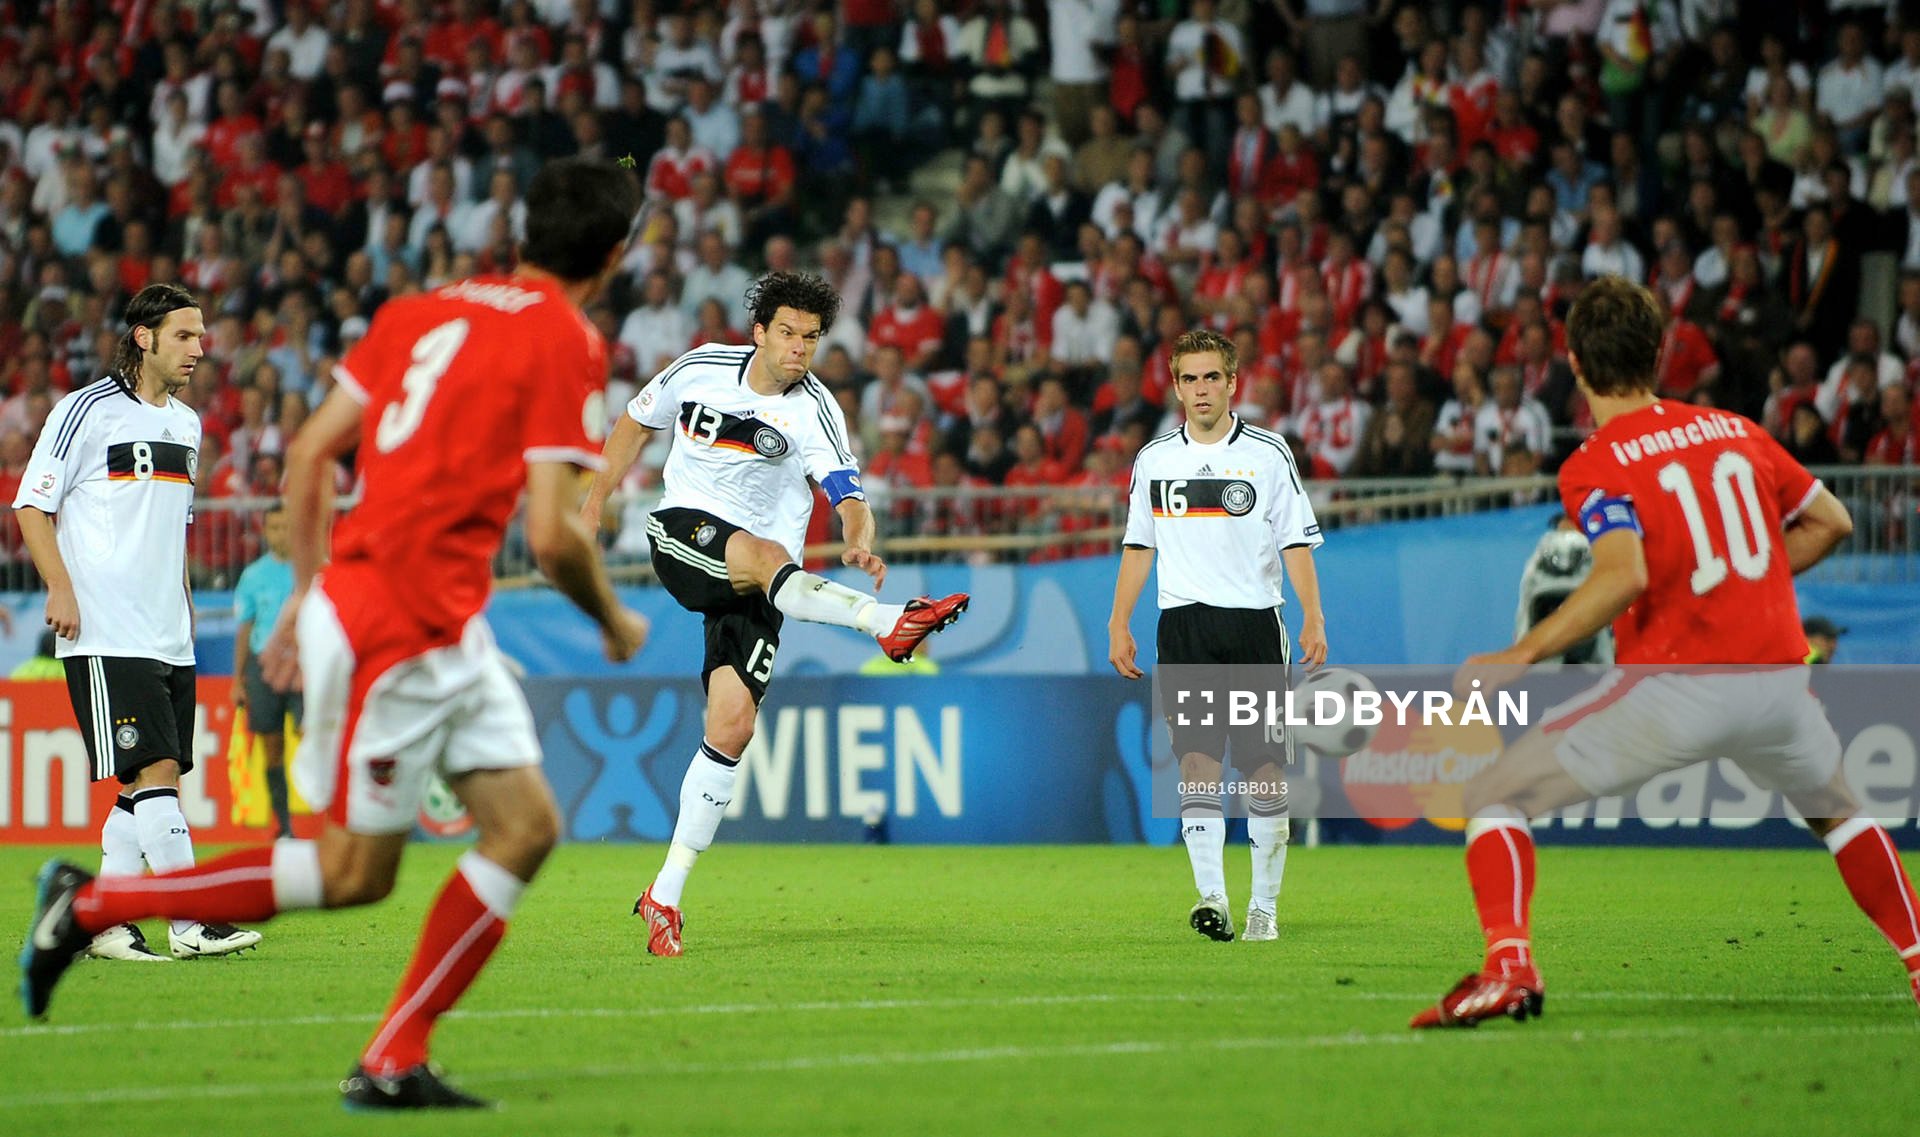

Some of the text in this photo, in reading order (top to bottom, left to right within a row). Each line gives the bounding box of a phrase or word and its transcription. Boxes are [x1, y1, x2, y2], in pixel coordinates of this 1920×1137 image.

[375, 317, 470, 455] 3
[688, 403, 722, 446] 13
[133, 442, 153, 480] 8
[1160, 480, 1188, 517] 16
[1658, 451, 1771, 596] 10
[746, 638, 775, 683] 13
[704, 704, 963, 820] WIEN
